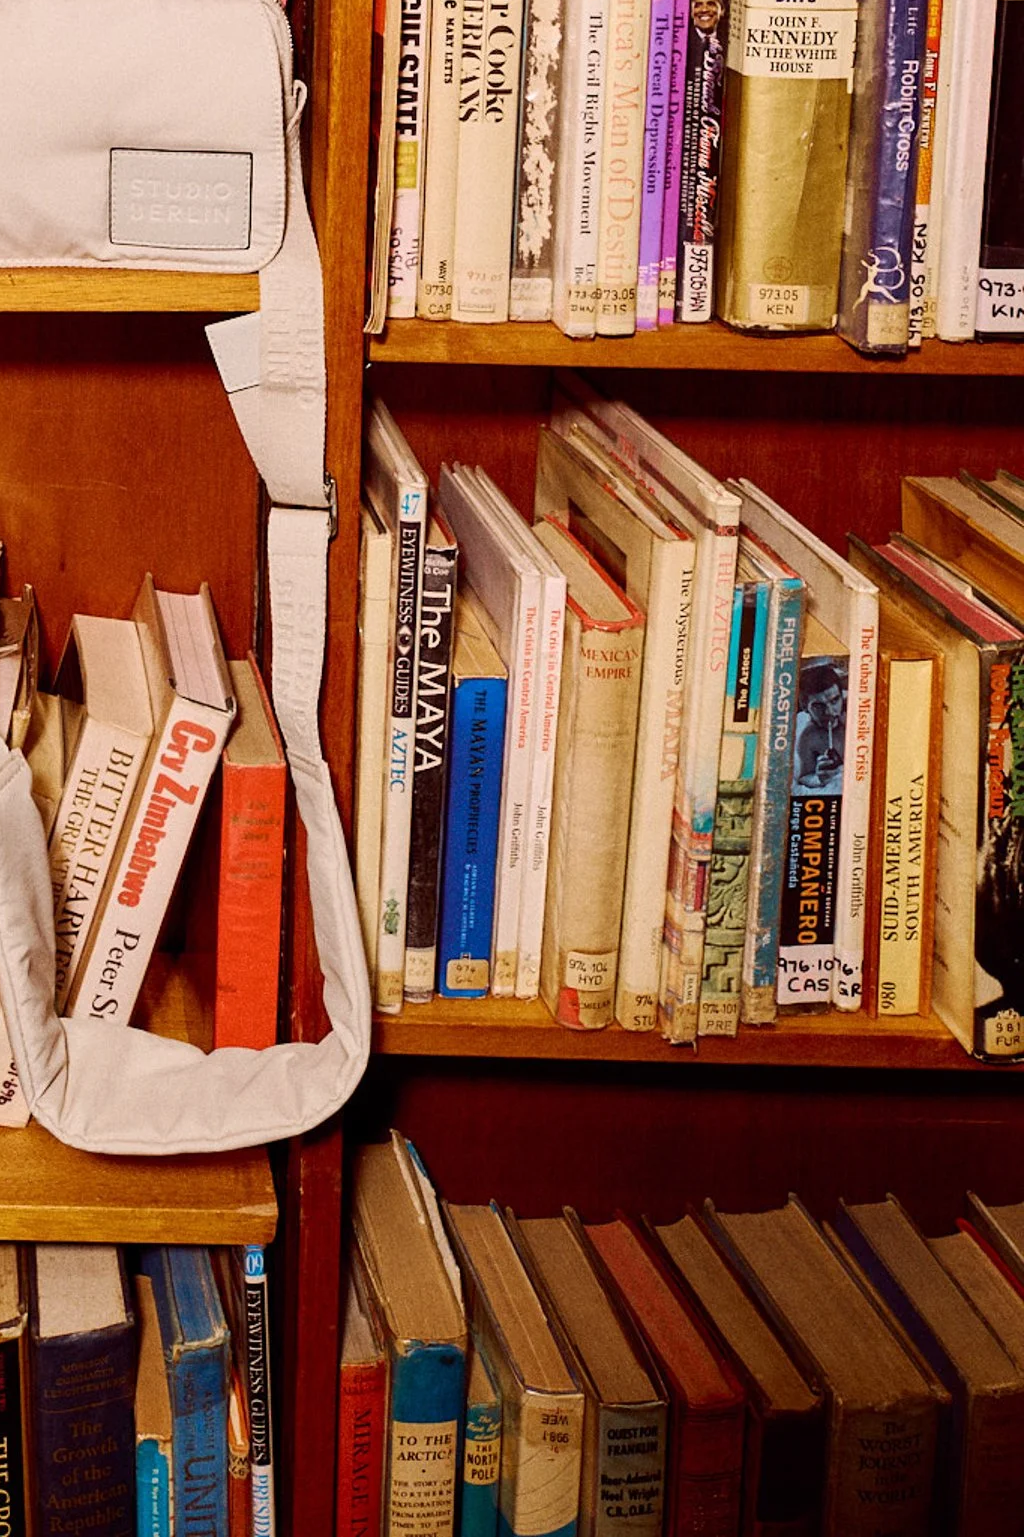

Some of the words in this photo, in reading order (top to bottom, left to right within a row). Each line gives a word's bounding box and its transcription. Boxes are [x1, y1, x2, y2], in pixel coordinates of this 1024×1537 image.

[447, 18, 455, 48] MARY
[589, 11, 603, 37] The
[655, 13, 669, 39] The
[748, 29, 837, 46] KENNEDY
[768, 16, 800, 28] JOHN
[807, 17, 820, 29] F.
[444, 52, 453, 84] LETTS
[585, 42, 602, 87] Civil
[746, 47, 763, 59] IN
[767, 47, 792, 59] THE
[796, 47, 837, 59] WHITE
[770, 60, 813, 73] HOUSE
[485, 23, 517, 123] Cooke
[651, 45, 666, 97] Great
[901, 60, 919, 112] Robin
[583, 88, 600, 143] Rights
[647, 102, 665, 195] Depression
[895, 113, 916, 171] Cross
[130, 179, 232, 201] STUDIO
[580, 149, 598, 235] Movement
[130, 204, 231, 225] BERLIN
[767, 304, 794, 316] KEN
[401, 493, 420, 515] 47
[398, 527, 418, 626] EYEWITNESS
[420, 584, 452, 649] The
[779, 618, 796, 671] FIDEL
[860, 625, 874, 650] The
[581, 647, 640, 663] MEXICAN
[738, 647, 752, 683] Aztecs
[394, 657, 411, 714] GUIDES
[585, 665, 633, 680] EMPIRE
[858, 653, 873, 694] Cuban
[737, 684, 748, 710] The
[775, 674, 792, 751] CASTRO
[415, 663, 448, 772] MAYA
[856, 698, 871, 748] Missile
[160, 720, 217, 773] Cry
[390, 727, 408, 794] AZTEC
[854, 750, 867, 782] Crisis
[117, 773, 199, 908] Zimbabwe
[907, 775, 925, 876] AMERICA
[853, 834, 866, 863] John
[882, 796, 903, 943] SUID-AMERIKA
[850, 865, 864, 918] Griffiths
[905, 881, 920, 942] SOUTH
[99, 927, 140, 990] Peter
[579, 975, 602, 985] HYD
[788, 978, 828, 993] CAS
[882, 981, 897, 1010] 980
[996, 1036, 1020, 1047] FUR
[246, 1289, 261, 1392] EYEWITNESS
[250, 1399, 268, 1462] GUIDES
[397, 1436, 418, 1446] TO
[424, 1434, 451, 1445] THE
[607, 1428, 635, 1440] QUEST
[638, 1427, 657, 1437] FOR
[467, 1454, 498, 1465] NORTH
[607, 1442, 657, 1456] FRANKLIN
[471, 1469, 495, 1480] POLE
